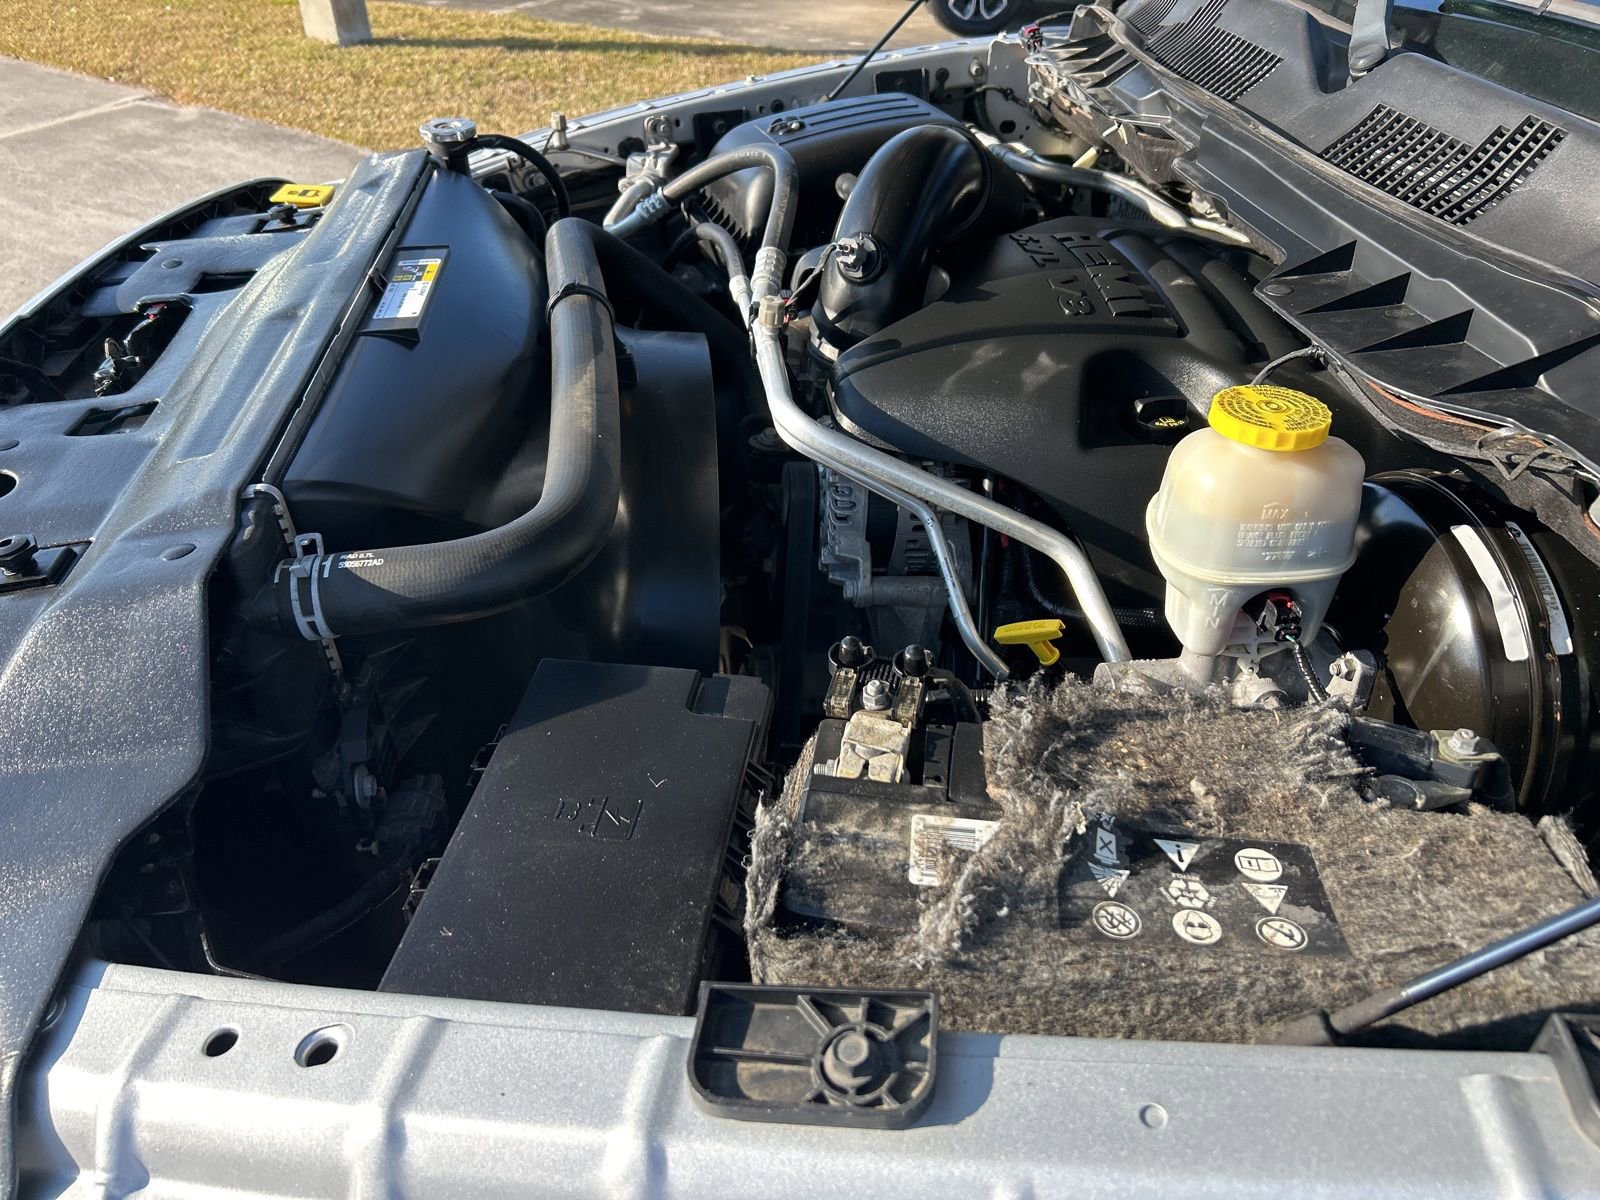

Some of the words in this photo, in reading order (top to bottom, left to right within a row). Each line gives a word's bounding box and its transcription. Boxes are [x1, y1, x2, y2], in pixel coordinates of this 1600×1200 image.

[1051, 231, 1152, 317] HEMI
[1047, 274, 1096, 316] V8
[1261, 508, 1289, 520] MAX
[1204, 592, 1229, 629] MIN
